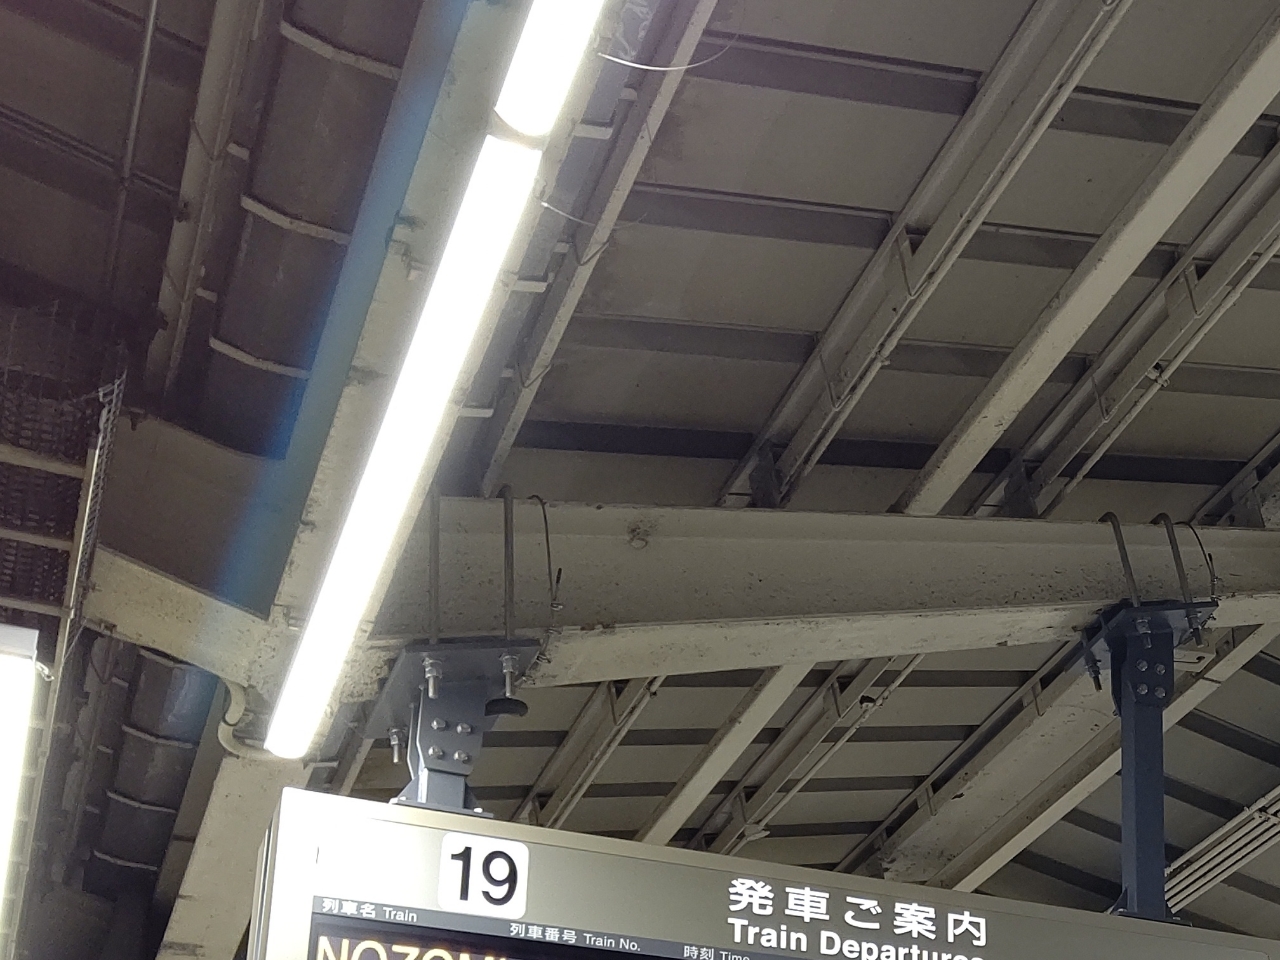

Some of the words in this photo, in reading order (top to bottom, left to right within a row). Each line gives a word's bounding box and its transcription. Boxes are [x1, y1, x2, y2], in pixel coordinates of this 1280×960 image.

[449, 845, 519, 906] 19
[322, 898, 376, 918] 列車名
[383, 907, 418, 922] Train
[728, 878, 988, 947] 発車ご案内
[509, 922, 577, 944] 列車番号
[583, 932, 615, 948] Train
[618, 937, 642, 952] No.
[727, 918, 808, 953] Train
